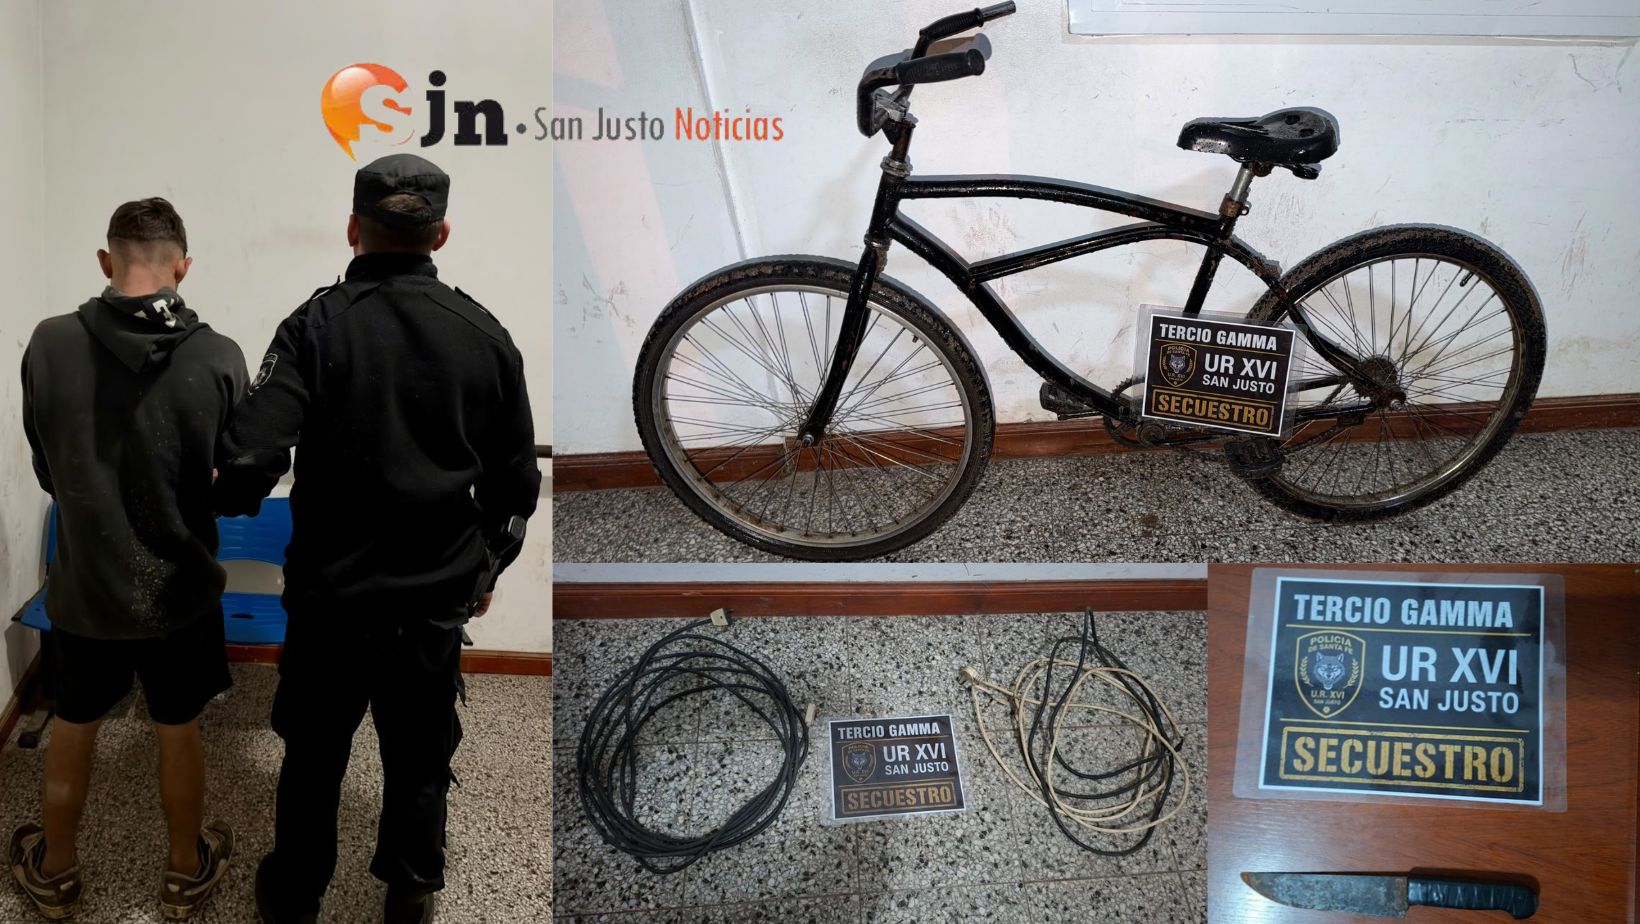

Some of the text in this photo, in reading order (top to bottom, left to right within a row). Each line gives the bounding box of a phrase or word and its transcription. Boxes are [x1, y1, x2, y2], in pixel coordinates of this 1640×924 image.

[1159, 323, 1277, 351] TERCIO GAMMA
[1204, 353, 1277, 380] UR XVI
[1202, 374, 1275, 394] SAN JUSTO
[1158, 394, 1269, 426] SECUESTRO
[1294, 594, 1513, 628] TERCIO GAMMA
[1381, 645, 1518, 685] UR XVI
[1379, 687, 1519, 714] SAN JUSTO
[838, 722, 940, 740] TERCIO GAMMA
[883, 745, 910, 762] UR
[914, 742, 947, 760] XVI
[1293, 736, 1514, 783] SECUESTRO
[885, 761, 949, 776] SAN JUSTO
[847, 785, 952, 810] SECUESTRO
